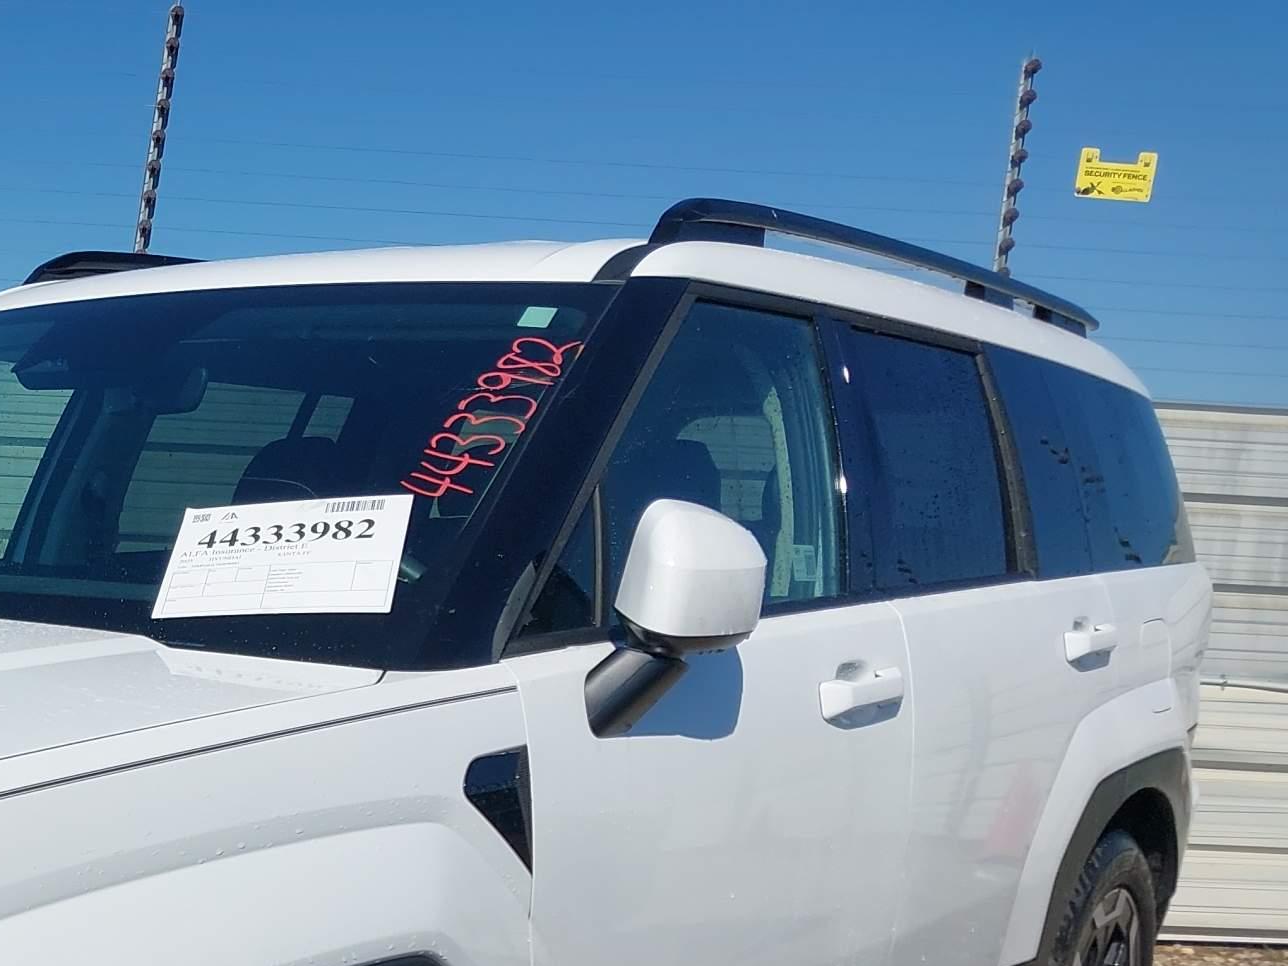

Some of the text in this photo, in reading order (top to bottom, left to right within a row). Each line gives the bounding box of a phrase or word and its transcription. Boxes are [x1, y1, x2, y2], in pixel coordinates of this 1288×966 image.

[1084, 170, 1149, 181] SECURITY FENCE
[400, 337, 581, 497] 44333982
[197, 519, 375, 549] 44333982
[212, 547, 255, 556] Insurance
